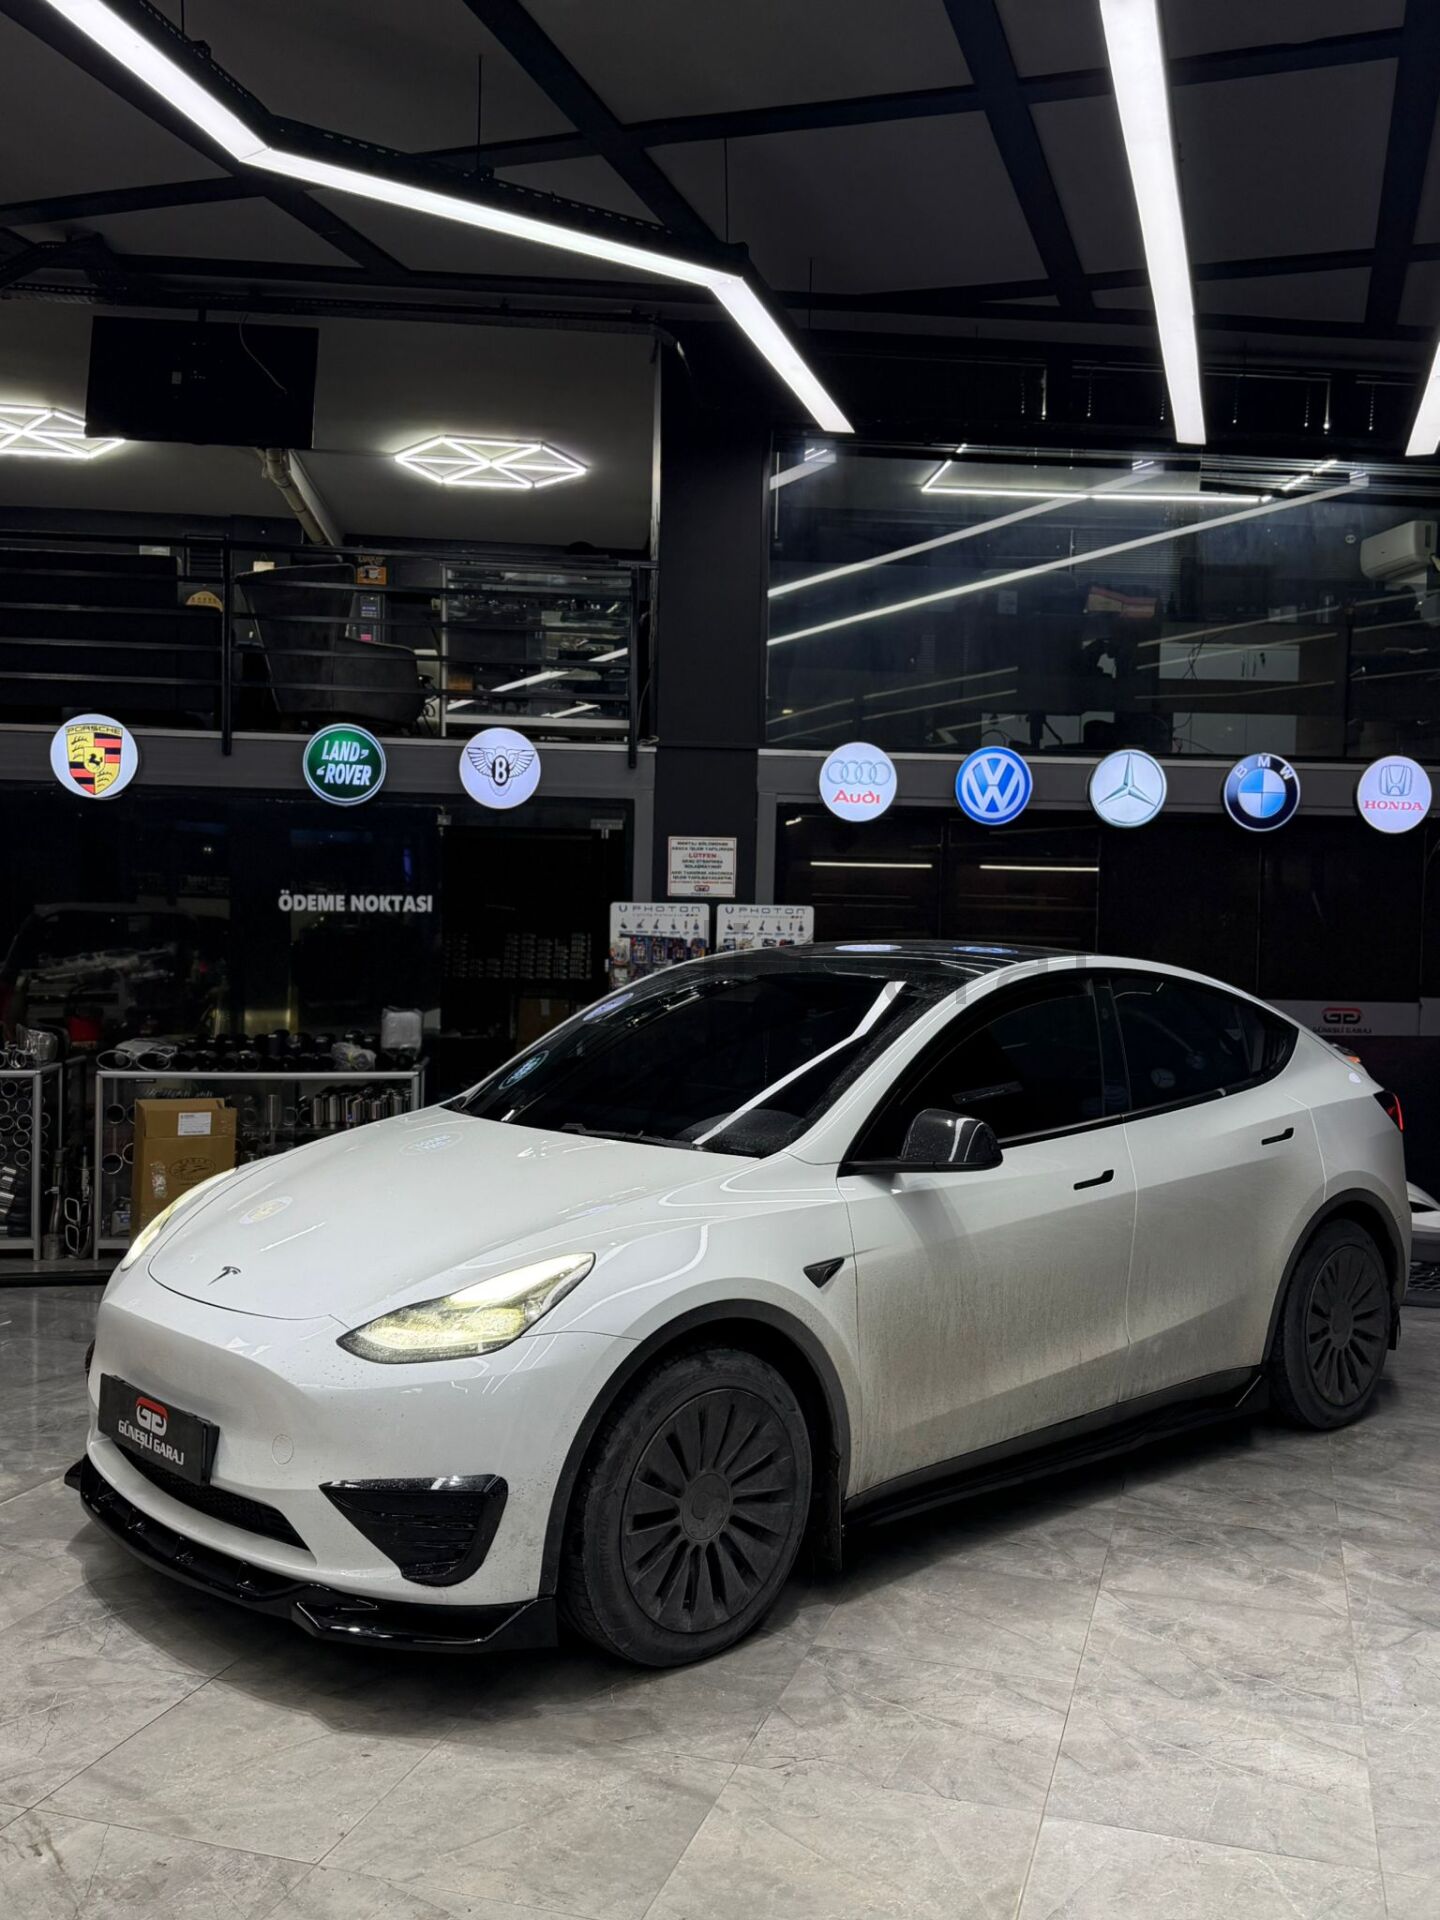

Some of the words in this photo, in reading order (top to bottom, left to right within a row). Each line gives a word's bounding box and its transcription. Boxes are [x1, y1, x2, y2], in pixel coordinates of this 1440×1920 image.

[67, 725, 121, 735] PORSCHE
[321, 740, 361, 762] LAND
[324, 763, 372, 786] ROVER
[1234, 756, 1295, 780] BMW
[832, 789, 881, 804] Audi
[1364, 800, 1425, 811] HONDA
[278, 889, 345, 912] ÖDEME
[350, 894, 433, 912] NOKTASI
[118, 1419, 153, 1449] GÜNEŞLİ
[153, 1440, 185, 1466] GARAJ
